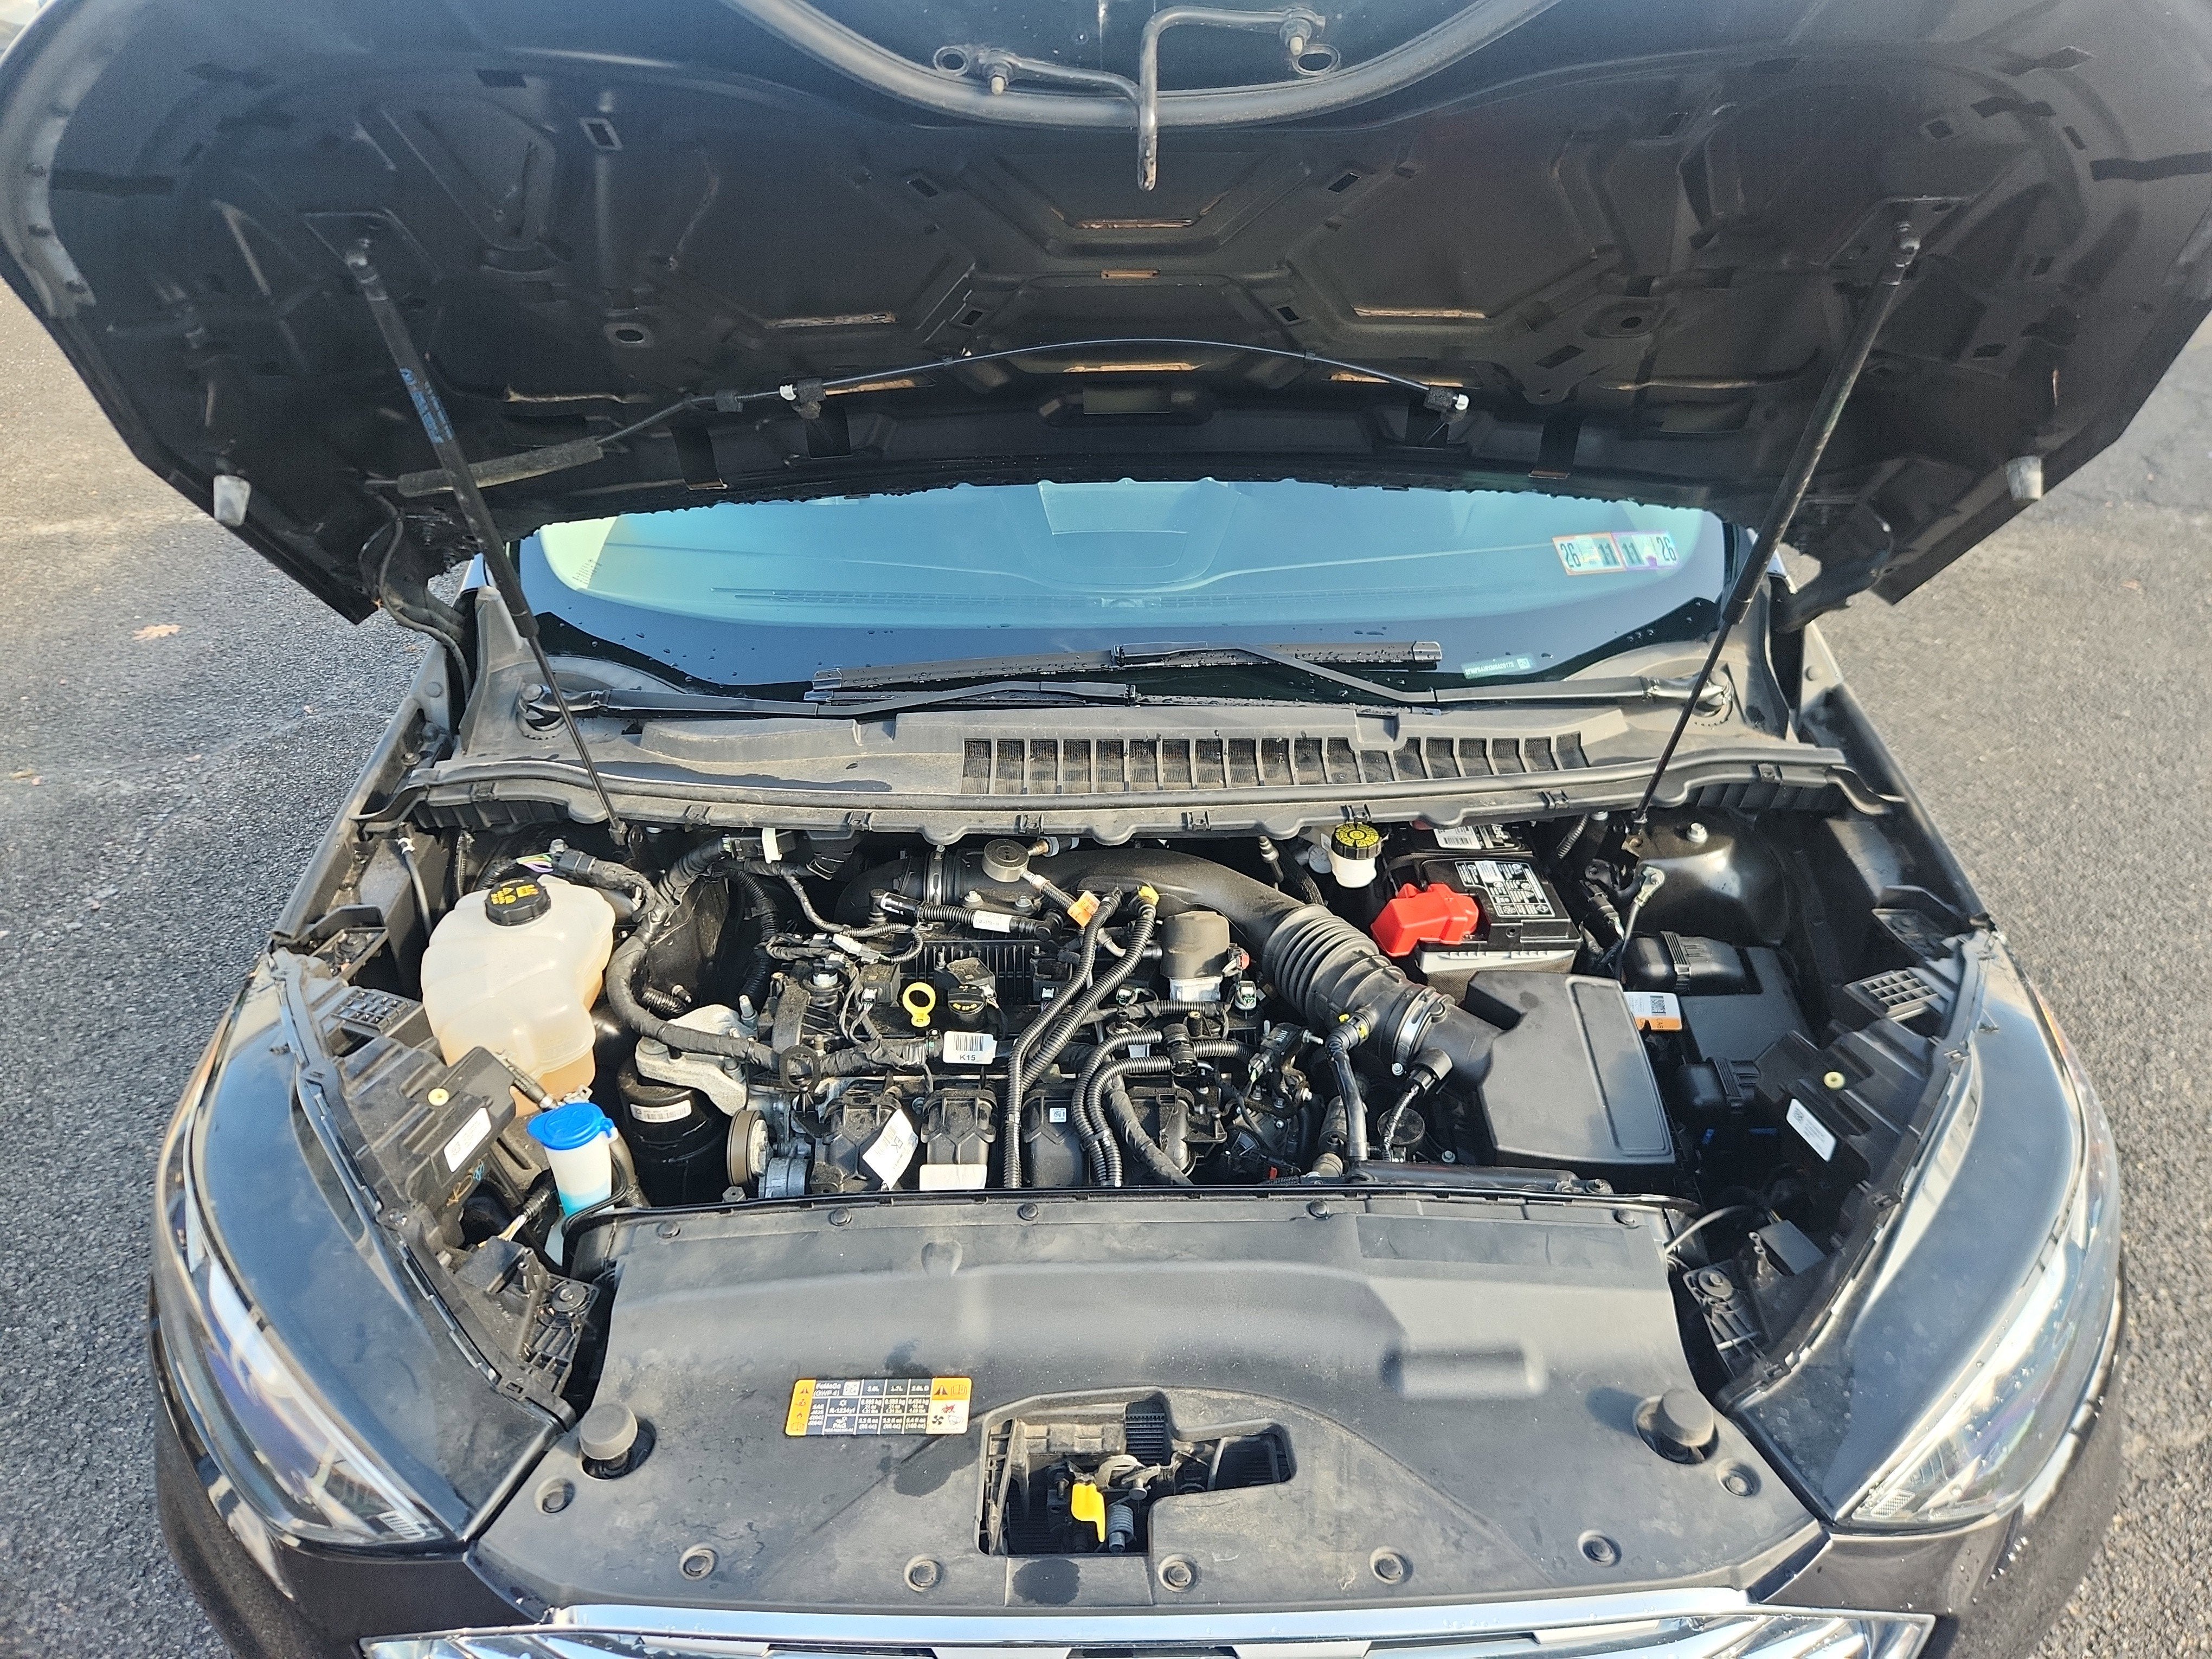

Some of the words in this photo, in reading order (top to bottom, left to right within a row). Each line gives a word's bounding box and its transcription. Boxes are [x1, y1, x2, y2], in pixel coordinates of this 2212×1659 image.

[1560, 543, 1581, 568] 26
[1598, 543, 1620, 565] 11
[1622, 542, 1644, 565] 11
[1657, 536, 1677, 562] 26
